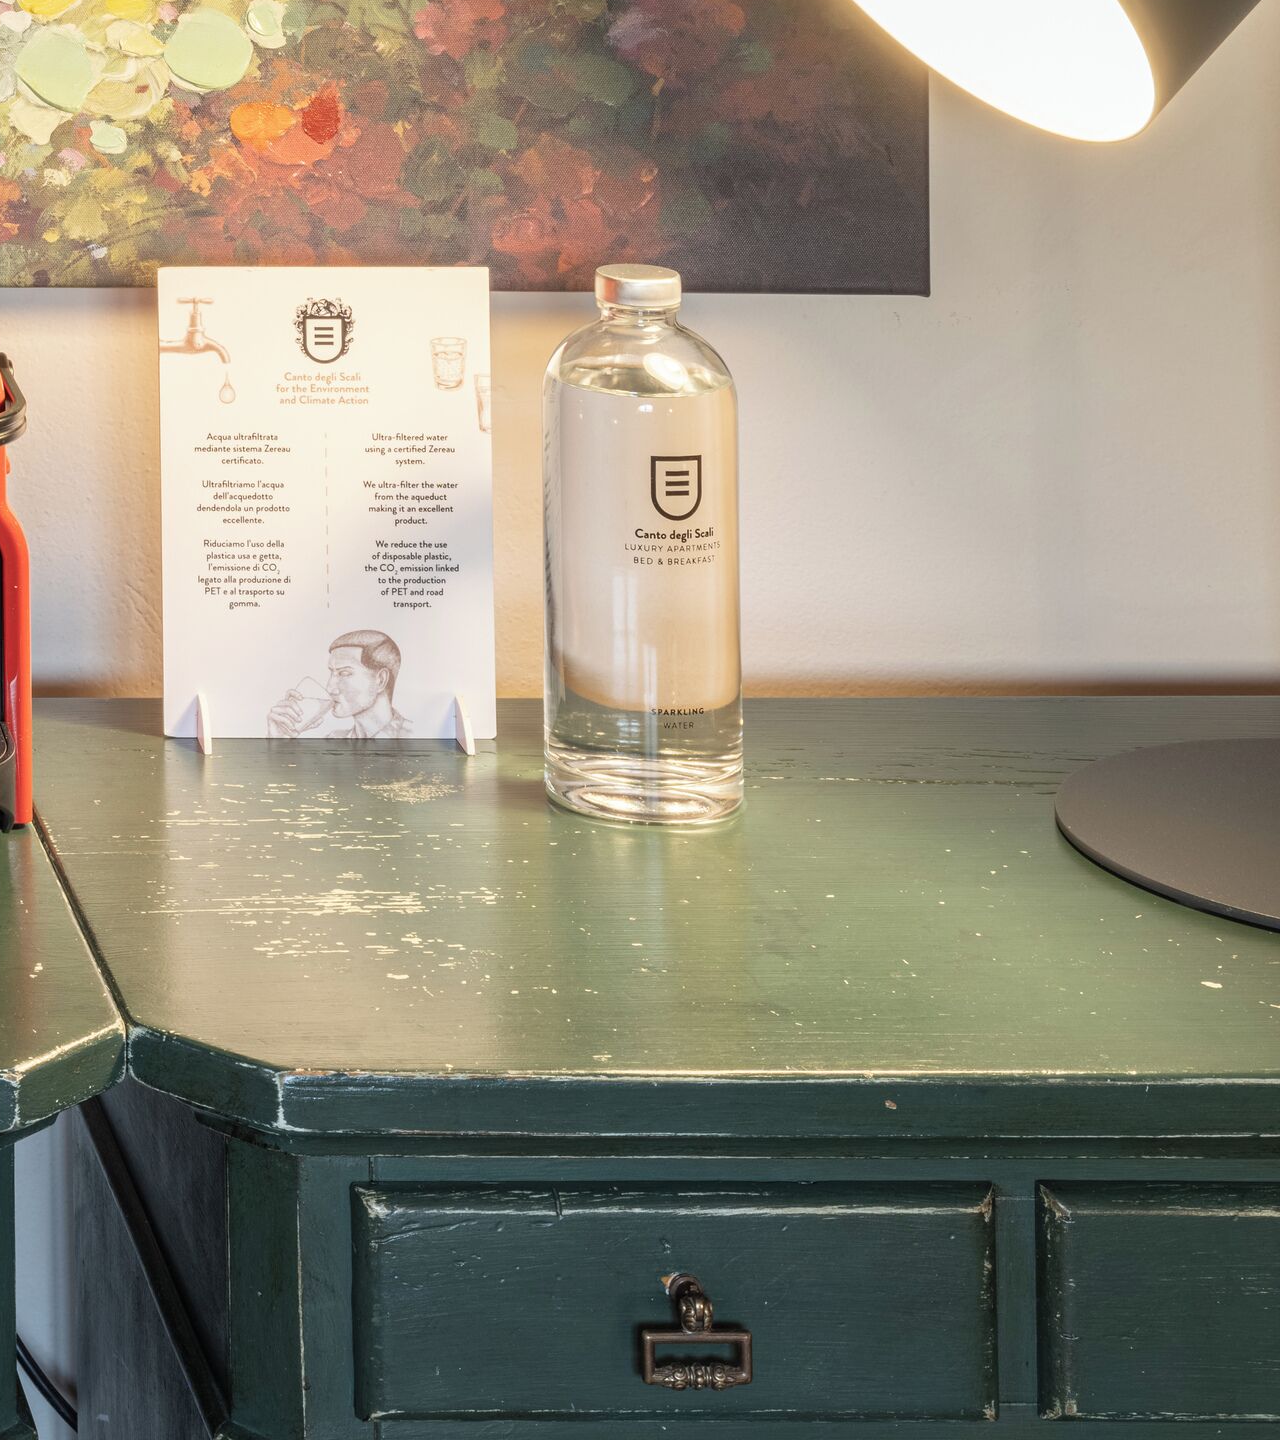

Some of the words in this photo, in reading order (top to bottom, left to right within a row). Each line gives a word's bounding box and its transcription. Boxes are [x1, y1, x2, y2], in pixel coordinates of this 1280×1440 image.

[284, 372, 312, 381] Canto
[315, 372, 336, 384] degli
[339, 373, 361, 381] Scali
[276, 385, 290, 393] for
[292, 385, 307, 393] the
[310, 384, 369, 393] Environment
[280, 396, 296, 404] and
[300, 396, 336, 404] Climate
[338, 396, 369, 405] Action
[206, 433, 231, 442] Acqua
[234, 433, 278, 441] ultrafiltrata
[372, 433, 424, 442] Ultra-filtered
[194, 445, 230, 453] mediante
[233, 445, 262, 453] sistema
[264, 445, 290, 453] Zereau
[365, 446, 385, 455] using
[393, 445, 426, 453] certified
[429, 445, 455, 453] Zereau
[221, 457, 264, 465] certificato.
[395, 458, 425, 467] system.
[202, 480, 255, 489] Ultrafiltriamo
[363, 481, 376, 489] We
[378, 480, 420, 489] ultra-filter
[421, 481, 435, 489] the
[374, 493, 394, 501] from
[396, 493, 409, 501] the
[411, 493, 447, 502] aqueduct
[256, 504, 290, 514] prodotto
[369, 505, 397, 514] making
[399, 505, 405, 513] it
[418, 505, 453, 513] excellent
[223, 516, 264, 524] eccellente.
[395, 517, 427, 526] product.
[634, 528, 667, 540] Canto
[669, 529, 692, 542] degli
[695, 527, 714, 539] Scali
[203, 540, 245, 548] Riduciamo
[267, 540, 284, 548] della
[376, 540, 388, 548] We
[390, 540, 418, 548] reduce
[419, 540, 433, 548] the
[624, 544, 663, 552] LUXURY
[667, 542, 720, 552] APARTMENTS
[206, 552, 235, 561] plastica
[259, 552, 282, 562] getta,
[372, 552, 380, 560] of
[382, 552, 422, 562] disposable
[424, 552, 452, 562] plastic,
[634, 557, 653, 565] BED
[668, 555, 715, 566] BREAKFAST
[253, 564, 260, 572] di
[365, 564, 378, 572] the
[435, 564, 459, 572] linked
[198, 576, 222, 585] legato
[223, 576, 236, 584] alla
[238, 576, 282, 585] produzione
[283, 576, 291, 584] di
[388, 576, 402, 584] the
[404, 576, 446, 586] production
[238, 588, 274, 597] trasporto
[381, 588, 389, 596] of
[410, 588, 424, 596] and
[426, 588, 444, 596] road
[229, 601, 260, 610] gomma.
[393, 600, 432, 609] transport.
[651, 708, 705, 716] SPARKLING
